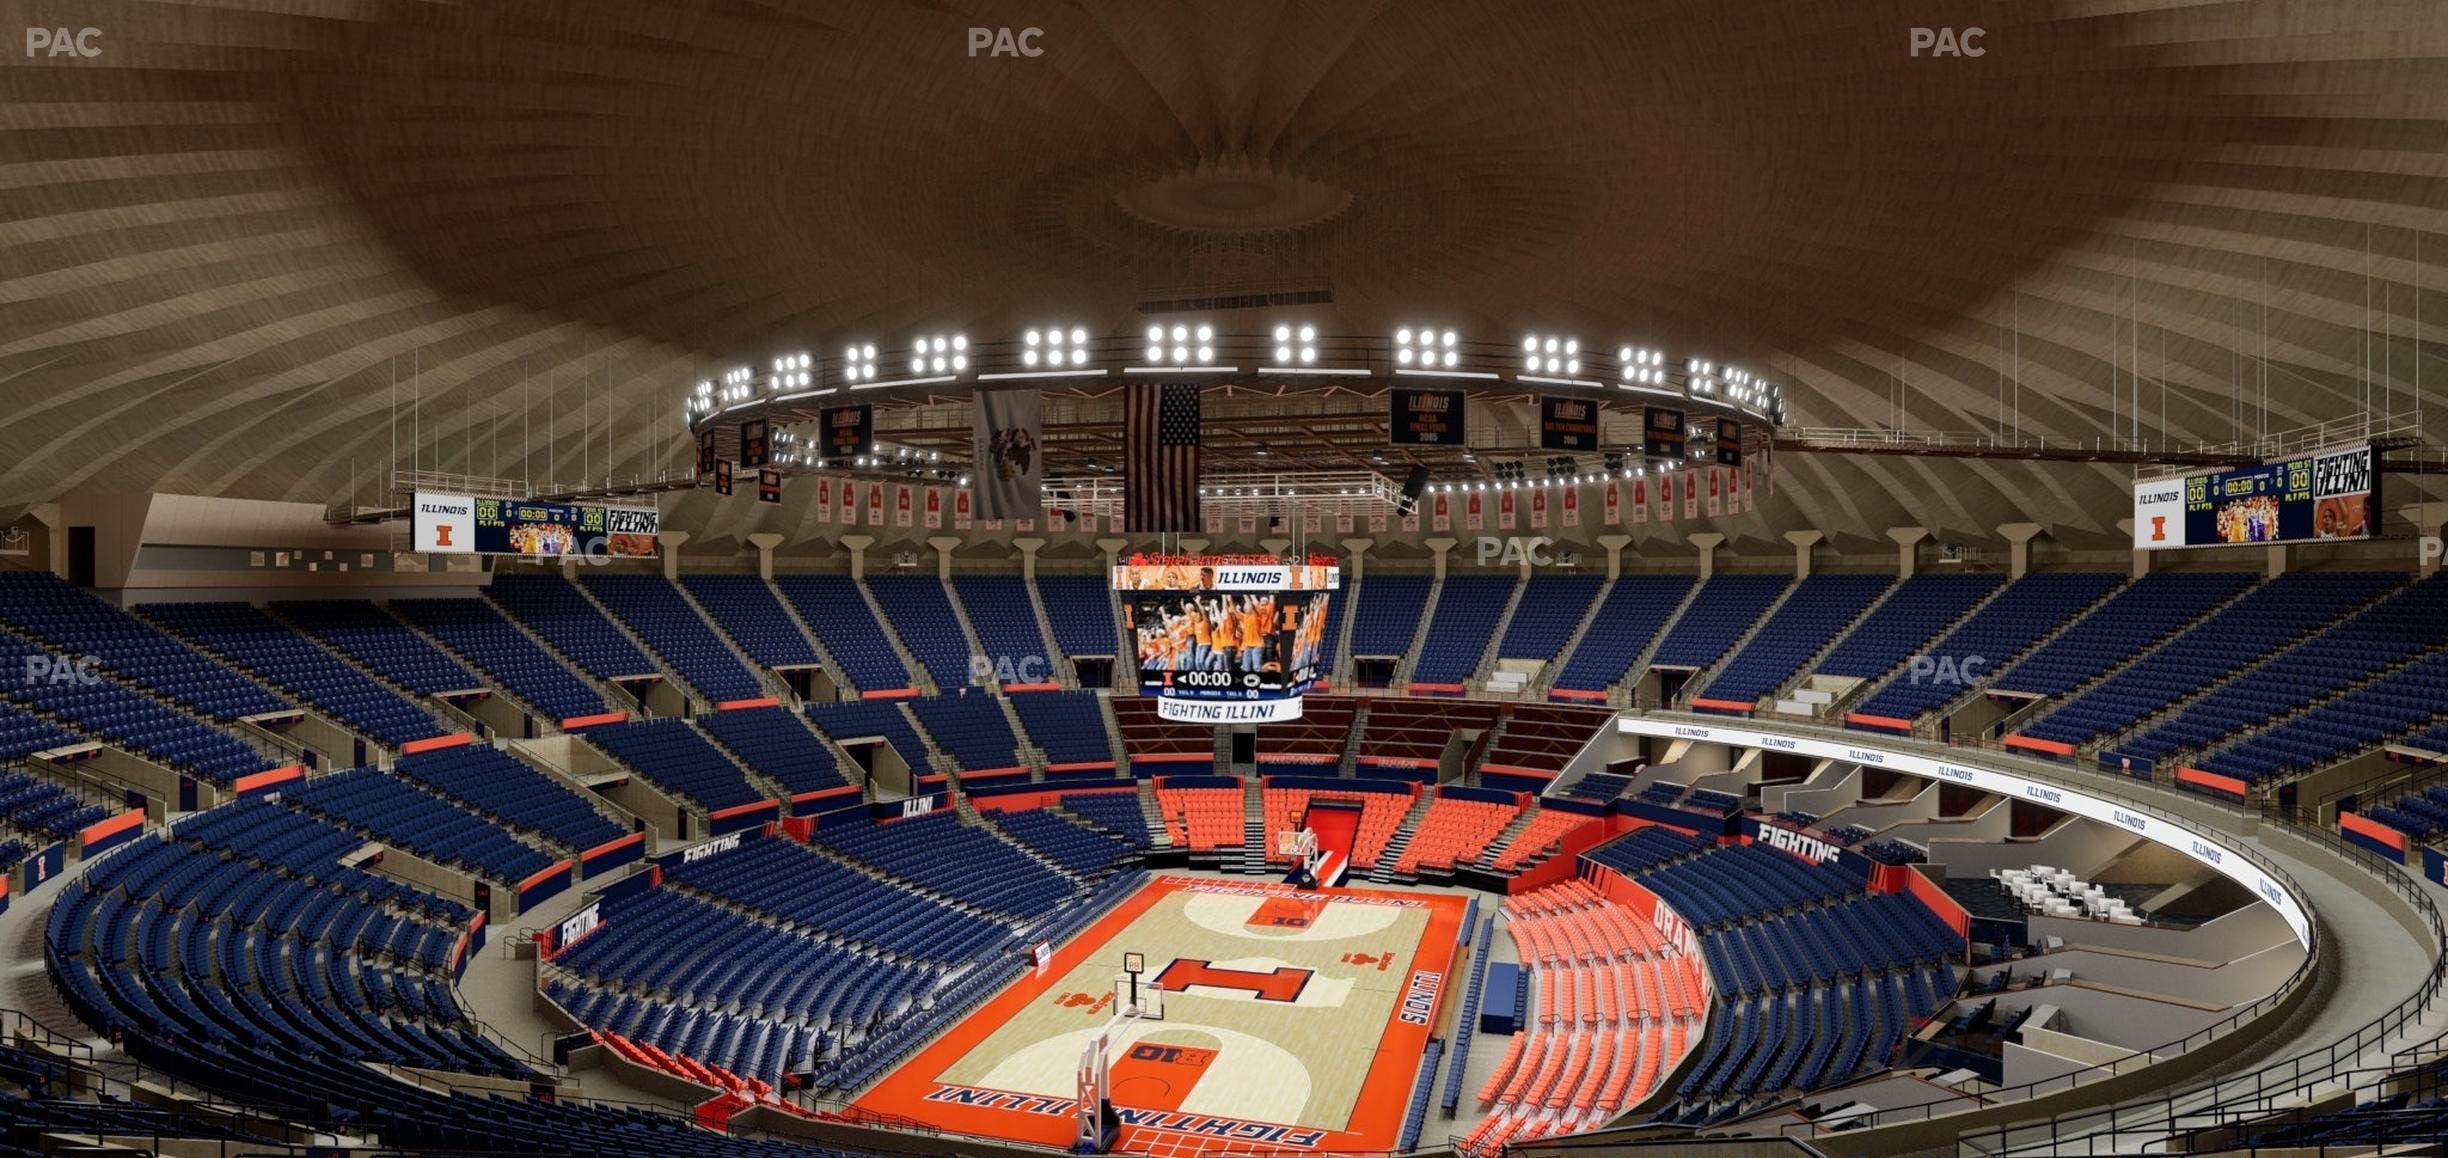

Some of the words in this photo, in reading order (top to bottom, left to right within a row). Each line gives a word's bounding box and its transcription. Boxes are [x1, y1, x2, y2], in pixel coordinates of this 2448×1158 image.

[2315, 449, 2370, 478] FIGHTING
[2227, 480, 2252, 493] 00:00
[2291, 472, 2308, 488] 00
[2138, 491, 2179, 505] ILLINOIS
[2188, 487, 2204, 502] 00
[421, 503, 468, 516] ILLINOIS
[478, 507, 496, 518] 00
[520, 509, 546, 519] 00:00
[608, 510, 656, 523] FIGHTING
[586, 514, 601, 525] 00
[436, 525, 453, 546] I
[2151, 516, 2166, 541] I
[1218, 572, 1282, 585] ILLINOIS
[1282, 605, 1299, 631] I
[1188, 672, 1231, 686] 00:00
[1163, 687, 1176, 697] 00
[1246, 689, 1259, 699] 00
[1162, 702, 1220, 719] FIGHTING
[1225, 704, 1276, 719] ILLINI
[1675, 727, 1709, 738] ILLINOIS
[1761, 737, 1796, 749] ILLINOIS
[1848, 749, 1884, 763] ILLINOIS
[1938, 766, 1973, 781] ILLINOIS
[2027, 785, 2061, 803] ILLINOIS
[903, 796, 934, 817] ILLINI
[2113, 810, 2146, 830] ILLINOIS
[684, 833, 741, 864] FIGHTING
[1757, 823, 1841, 863] FIGHTING
[561, 903, 600, 948] FIGHTING
[1153, 958, 1315, 1003] I
[1398, 969, 1442, 1026] ILLINOIS
[922, 1085, 1078, 1117] ILLINI
